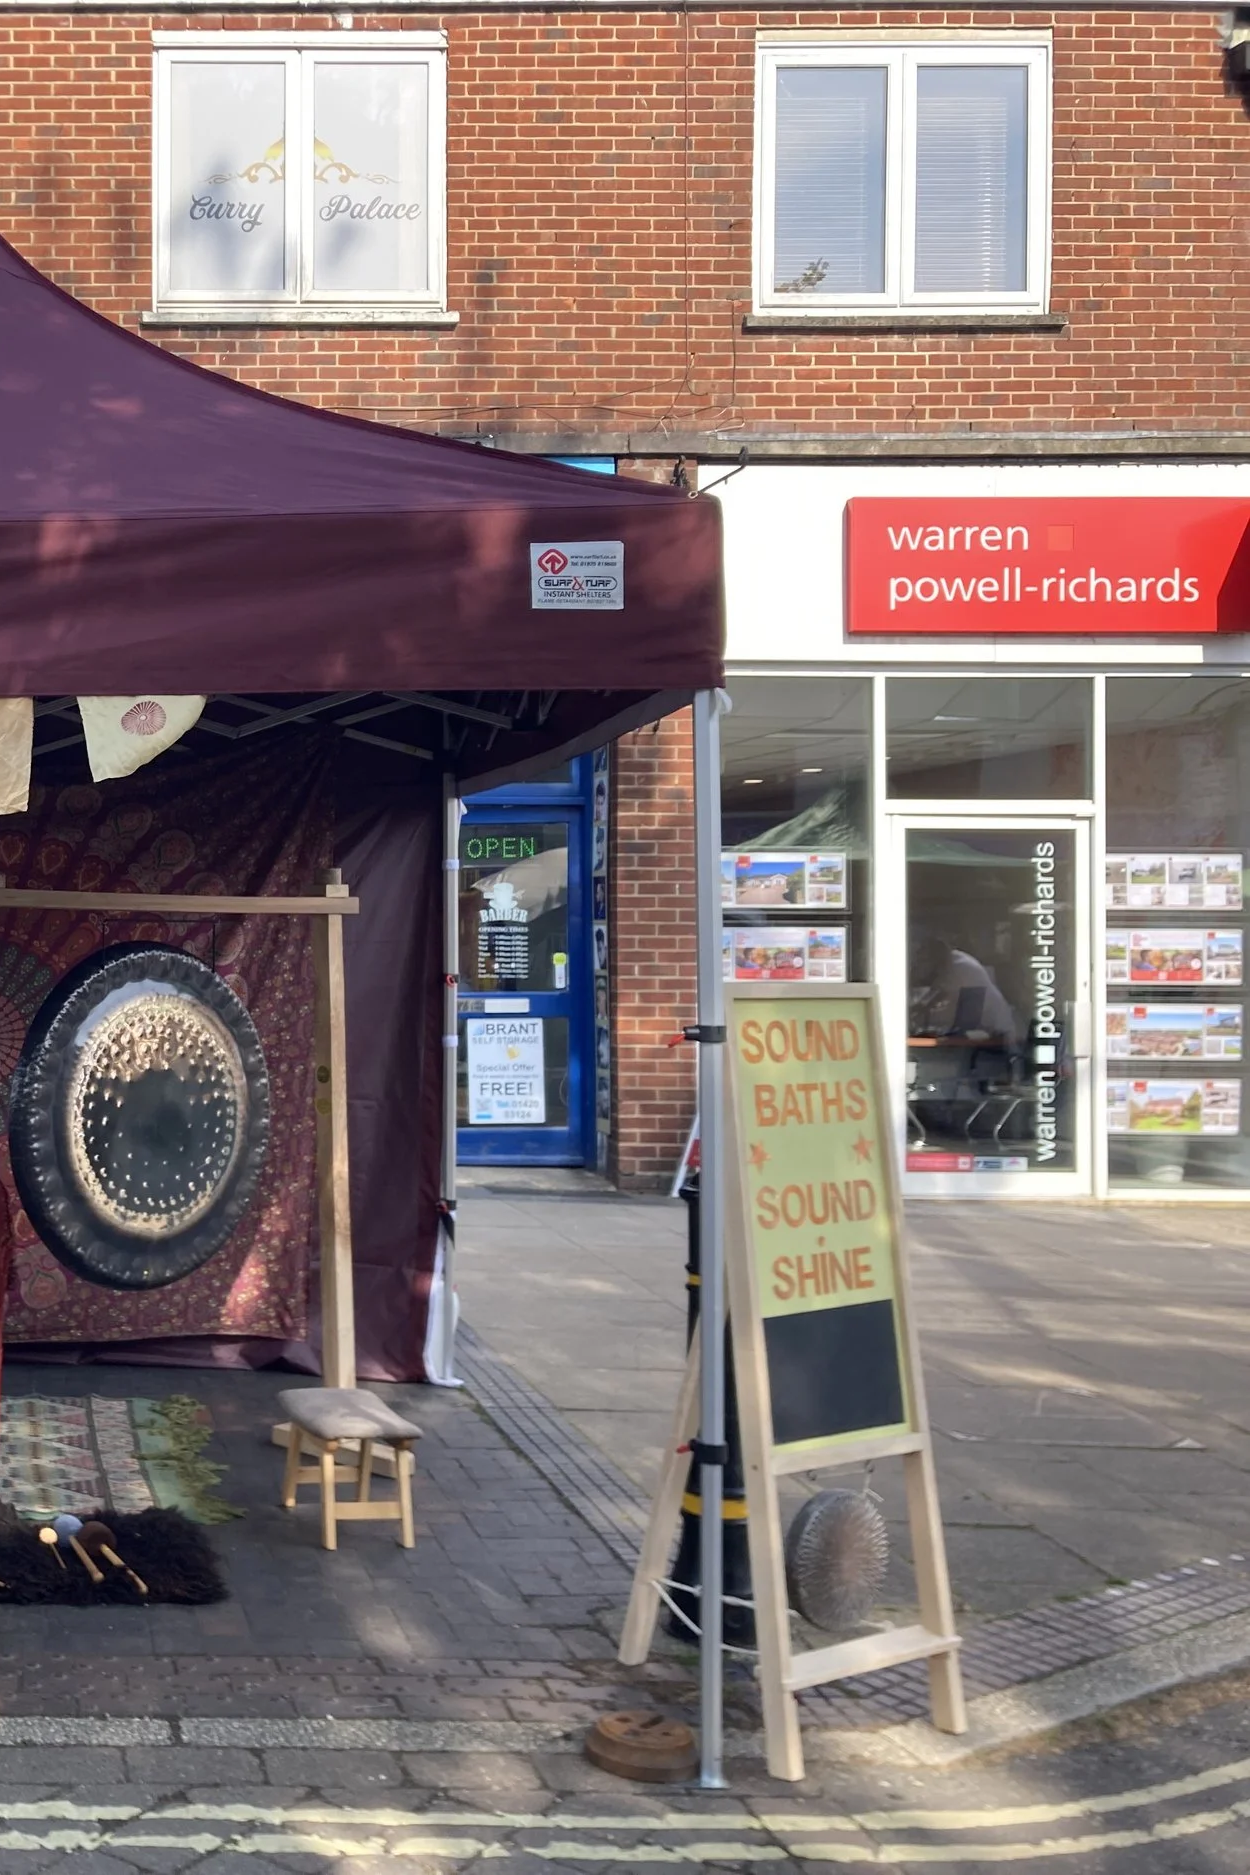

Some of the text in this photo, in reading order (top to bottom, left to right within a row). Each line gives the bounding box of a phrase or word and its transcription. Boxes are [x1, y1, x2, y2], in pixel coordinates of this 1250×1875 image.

[189, 193, 421, 233] Curry Palace
[887, 523, 1030, 551] warren
[544, 579, 573, 587] SURF
[585, 579, 612, 587] TURF
[576, 591, 612, 599] SHELTERS
[889, 567, 1200, 610] powell-richards
[467, 837, 535, 858] OPEN
[479, 908, 528, 923] BARBER
[1030, 841, 1057, 1041] powell-richards
[486, 1023, 539, 1035] BRANT
[741, 1019, 860, 1064] SOUND
[480, 1082, 533, 1096] FREE!
[754, 1077, 868, 1128] BATHS
[1036, 1070, 1057, 1162] warren
[756, 1179, 876, 1230] SOUND
